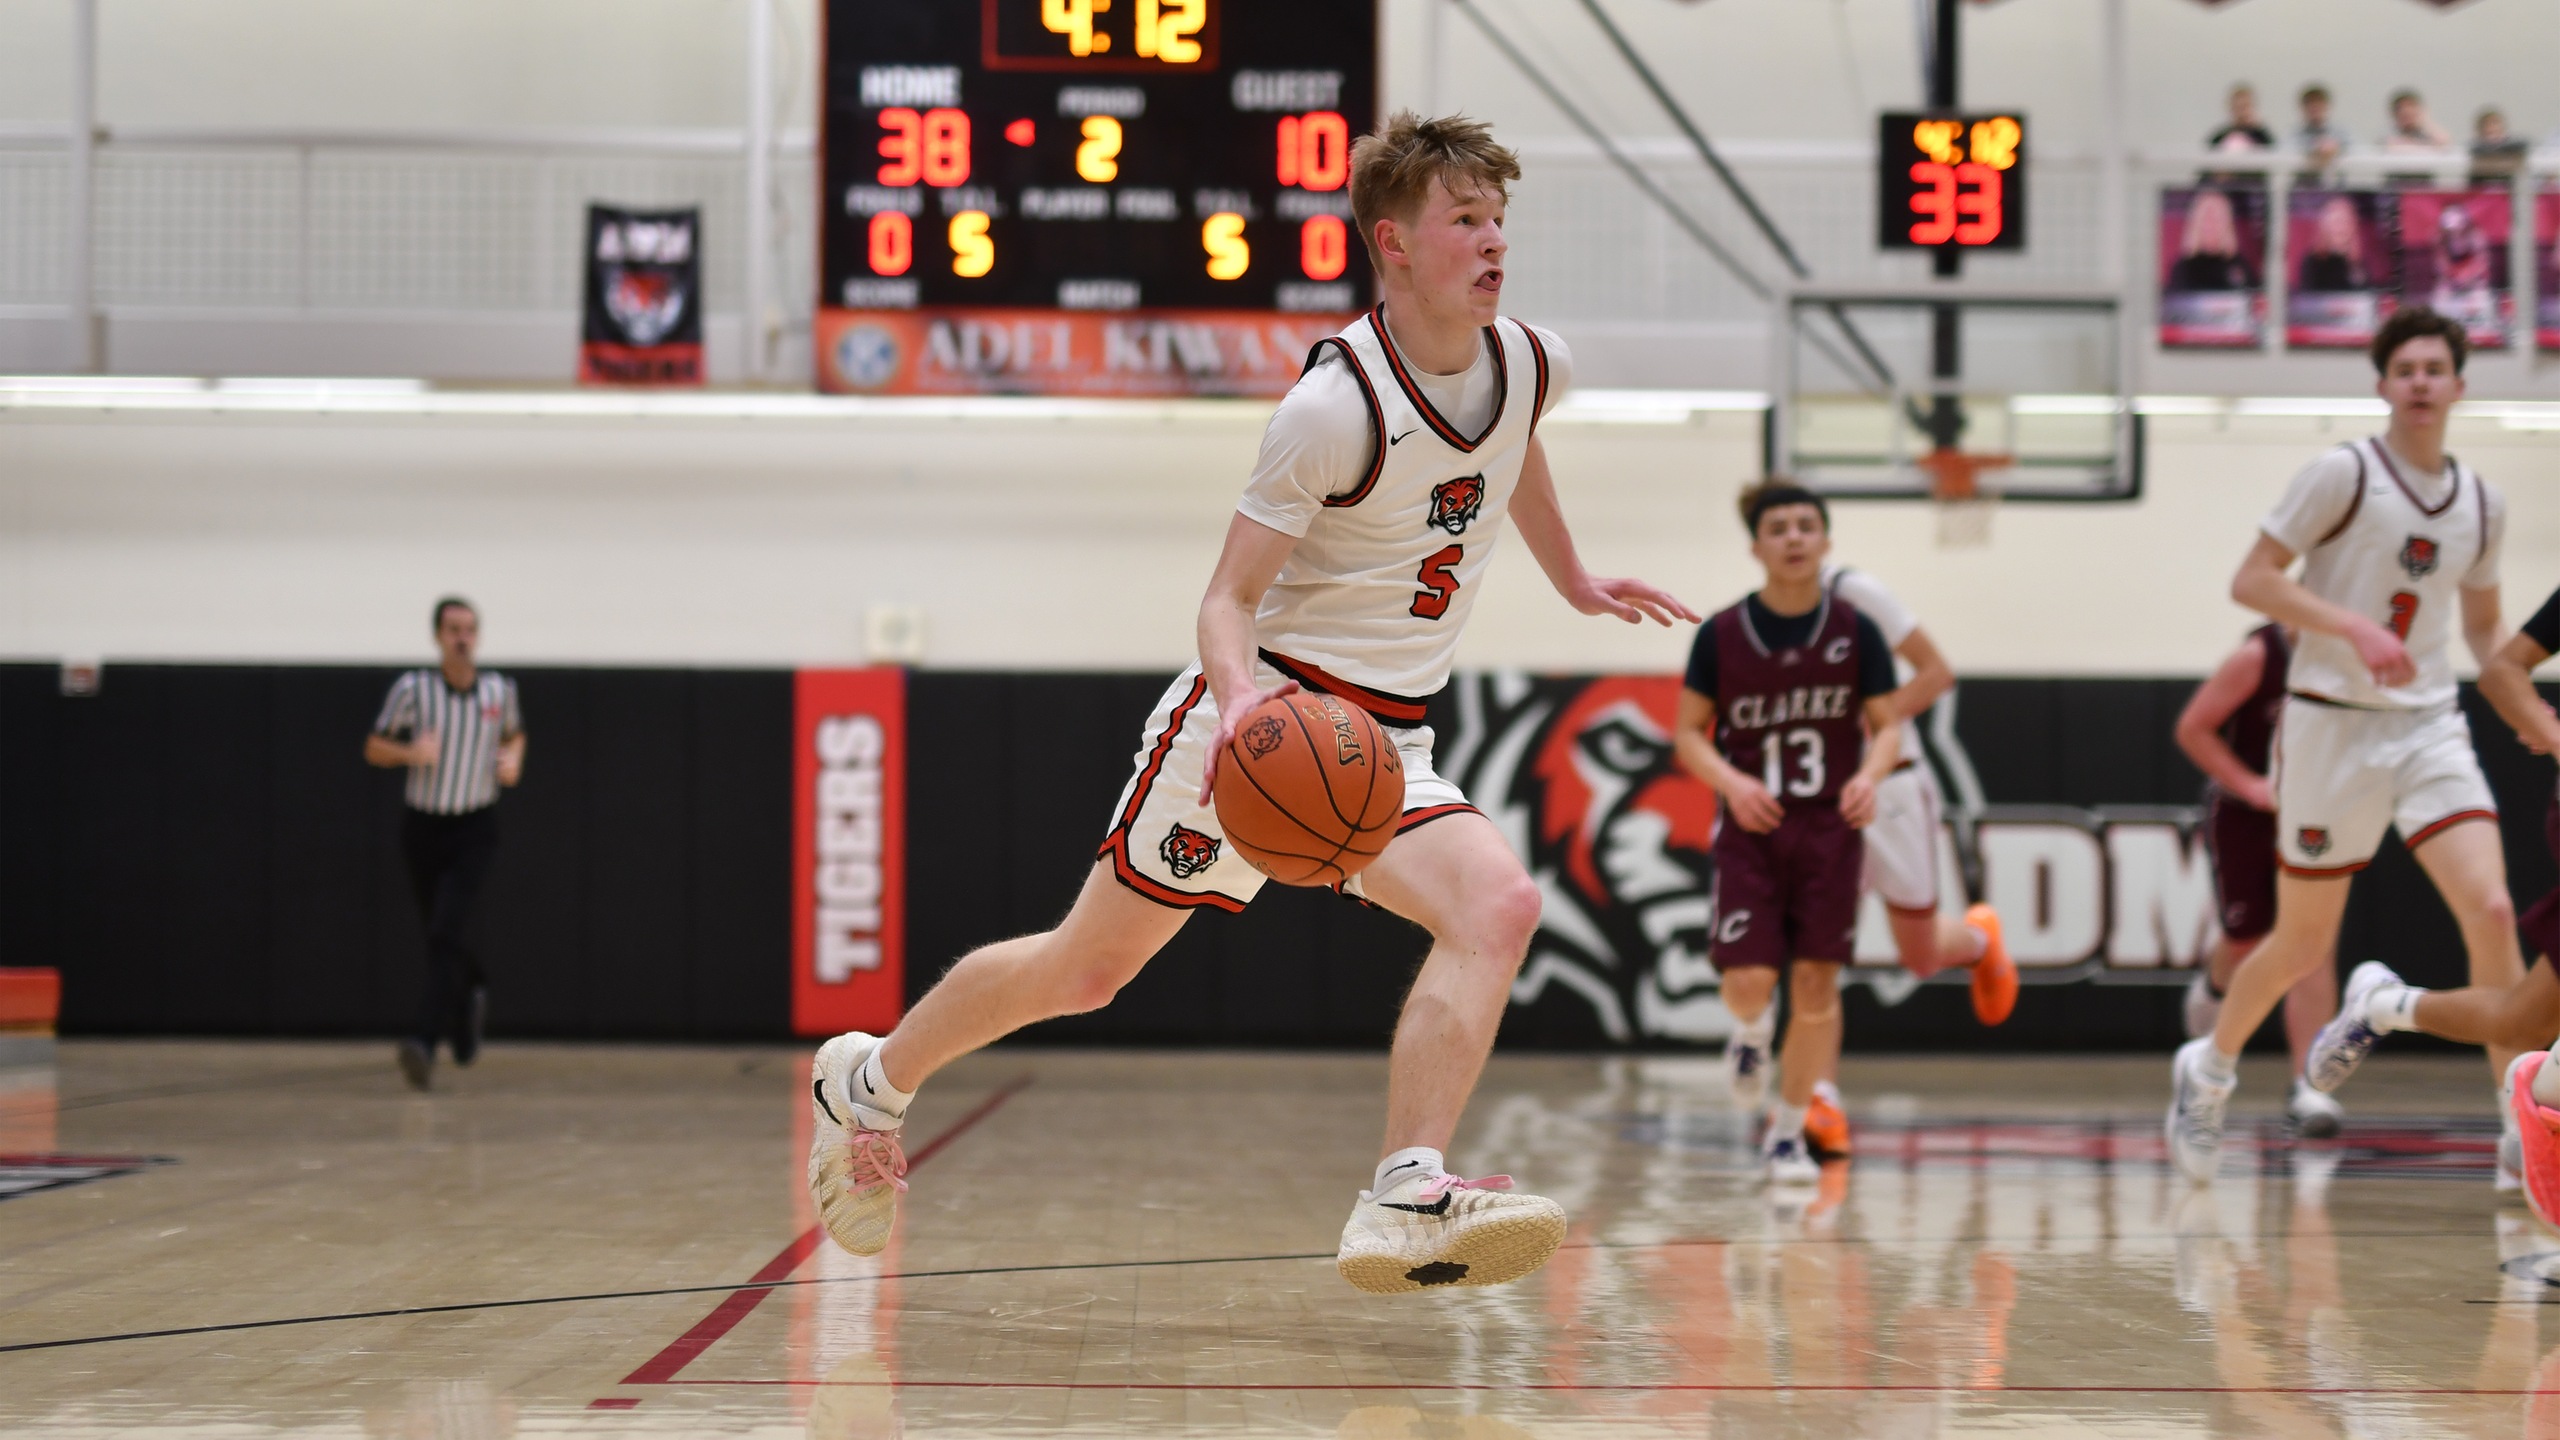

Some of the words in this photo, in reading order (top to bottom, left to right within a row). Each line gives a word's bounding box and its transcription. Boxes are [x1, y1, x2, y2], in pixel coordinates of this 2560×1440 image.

[1042, 0, 1206, 63] 4:12
[861, 67, 961, 106] HOME
[1231, 70, 1343, 111] GUEST
[878, 107, 971, 187] 38
[1077, 115, 1122, 182] 2
[1277, 111, 1348, 191] 10
[1909, 162, 2002, 245] 33
[868, 210, 912, 276] 0
[949, 210, 994, 277] 5
[1202, 212, 1249, 280] 5
[1301, 214, 1347, 280] 0
[1409, 544, 1464, 621] 5
[1824, 636, 1852, 664] C
[1729, 686, 1851, 730] CLARKE
[1762, 726, 1826, 798] 13
[814, 712, 886, 984] TIGERS
[1720, 910, 1751, 943] C
